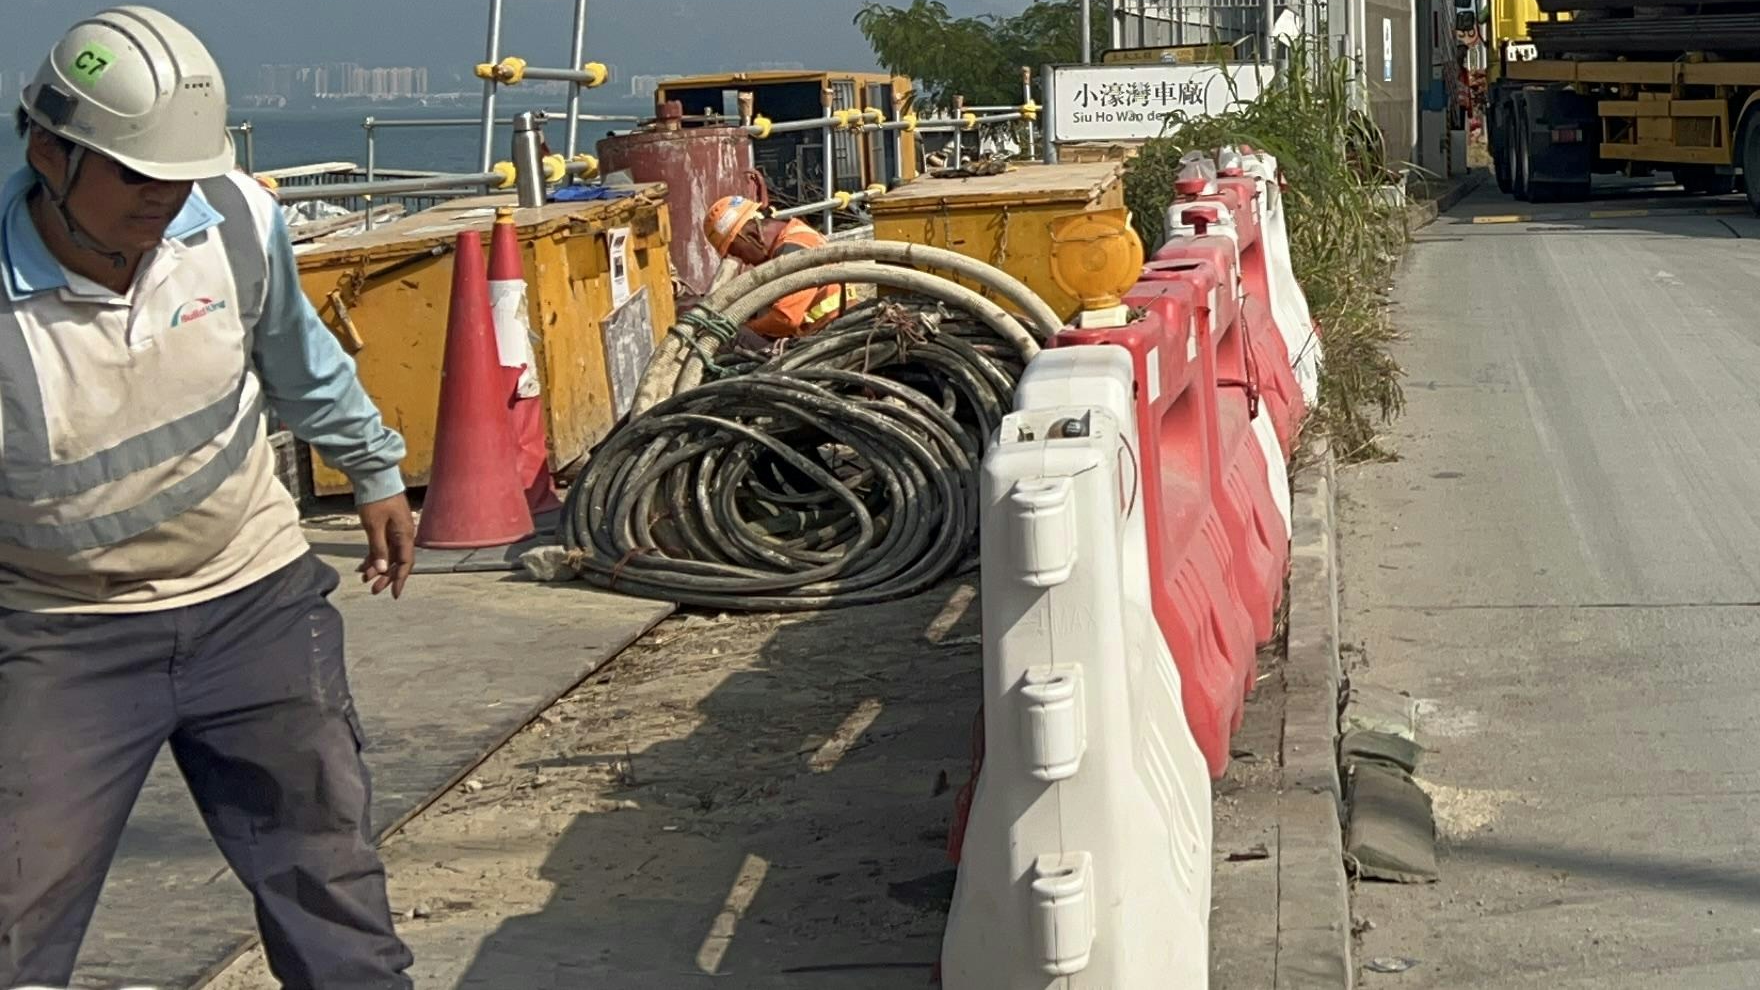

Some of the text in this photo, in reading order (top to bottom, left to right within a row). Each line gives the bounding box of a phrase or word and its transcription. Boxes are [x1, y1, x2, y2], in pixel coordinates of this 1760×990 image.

[75, 50, 107, 75] C7
[1073, 81, 1203, 108] 小濠灣車廠
[1073, 111, 1092, 123] Siu
[1096, 111, 1113, 122] Ho
